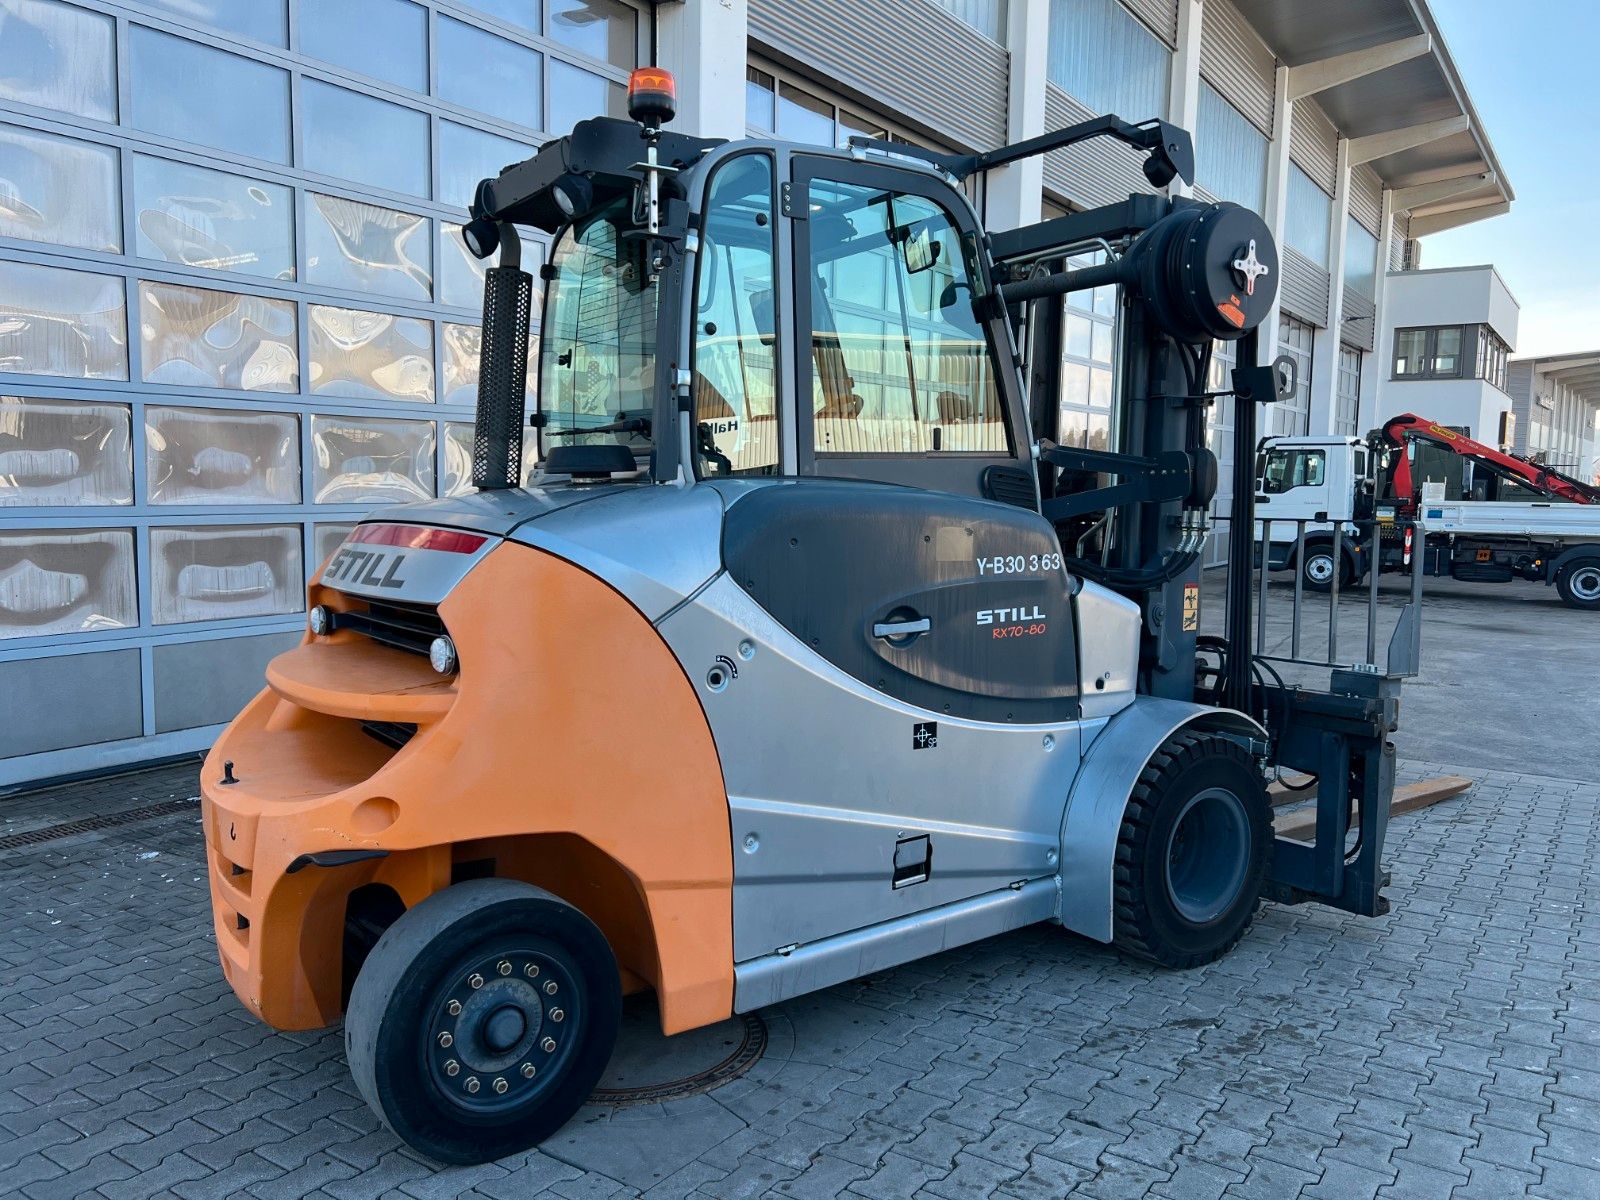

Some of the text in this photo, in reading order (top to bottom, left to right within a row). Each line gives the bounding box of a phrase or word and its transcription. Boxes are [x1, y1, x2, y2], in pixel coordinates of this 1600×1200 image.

[325, 549, 406, 588] STILL
[977, 556, 1025, 575] Y-B30
[977, 605, 1046, 625] STILL
[992, 623, 1046, 639] RX70-80
